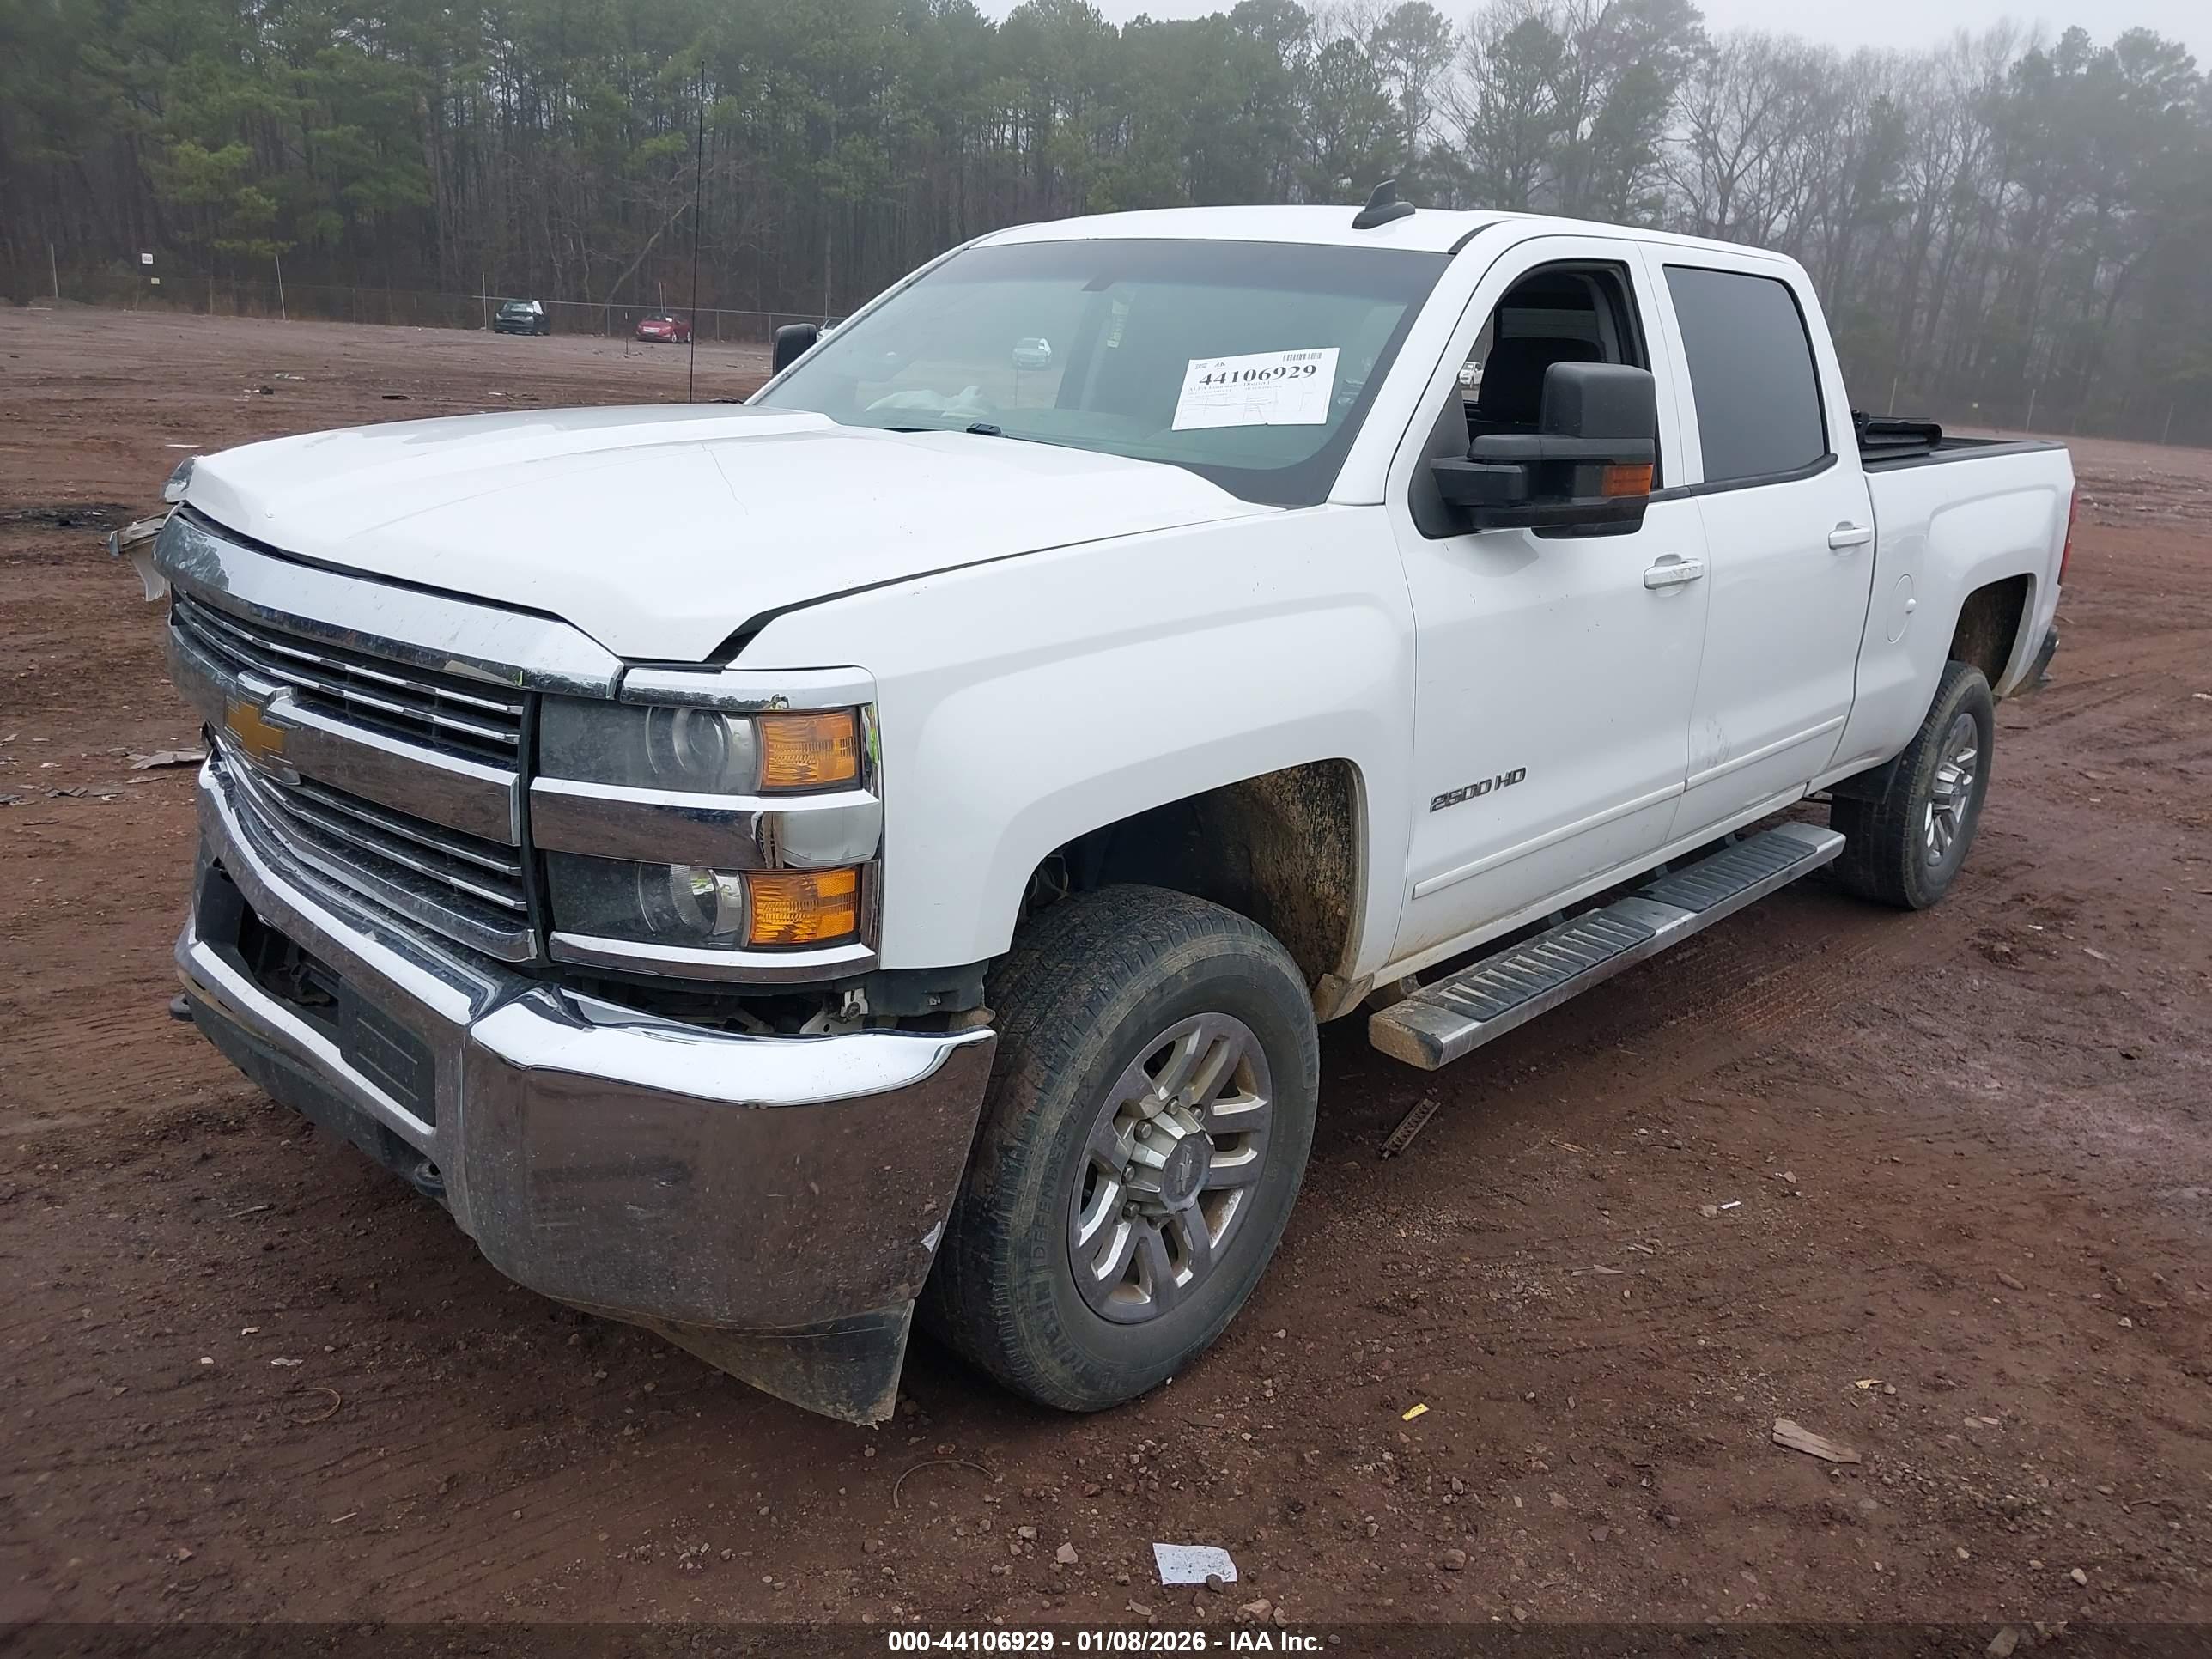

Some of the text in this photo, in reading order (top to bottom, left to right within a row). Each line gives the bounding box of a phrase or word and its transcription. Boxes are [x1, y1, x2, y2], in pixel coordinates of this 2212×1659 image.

[1199, 364, 1317, 386] 44106929
[1429, 767, 1526, 812] 2500 HD
[1033, 1131, 1069, 1259] DEFENDER
